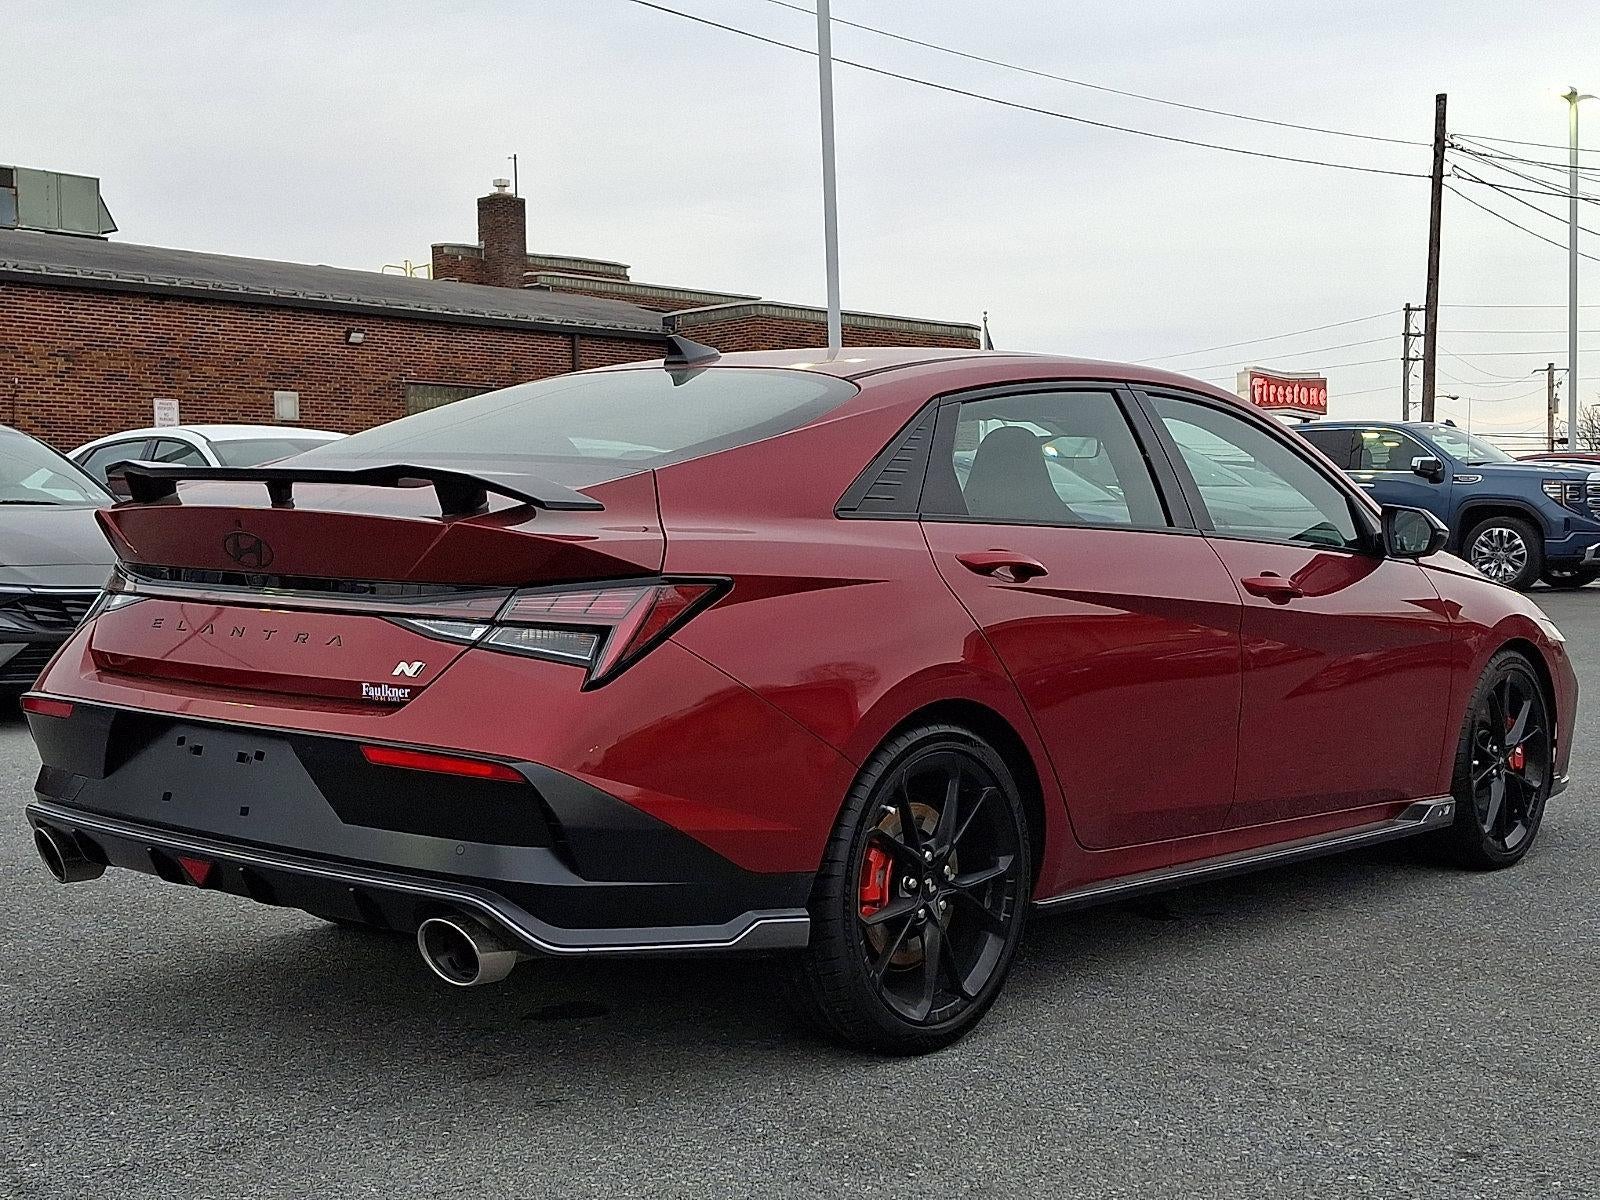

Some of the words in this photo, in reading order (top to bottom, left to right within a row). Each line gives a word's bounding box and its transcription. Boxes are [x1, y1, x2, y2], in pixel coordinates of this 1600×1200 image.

[1251, 377, 1327, 406] Firestone
[152, 618, 343, 647] ELANTRA
[361, 682, 410, 698] Faulkner
